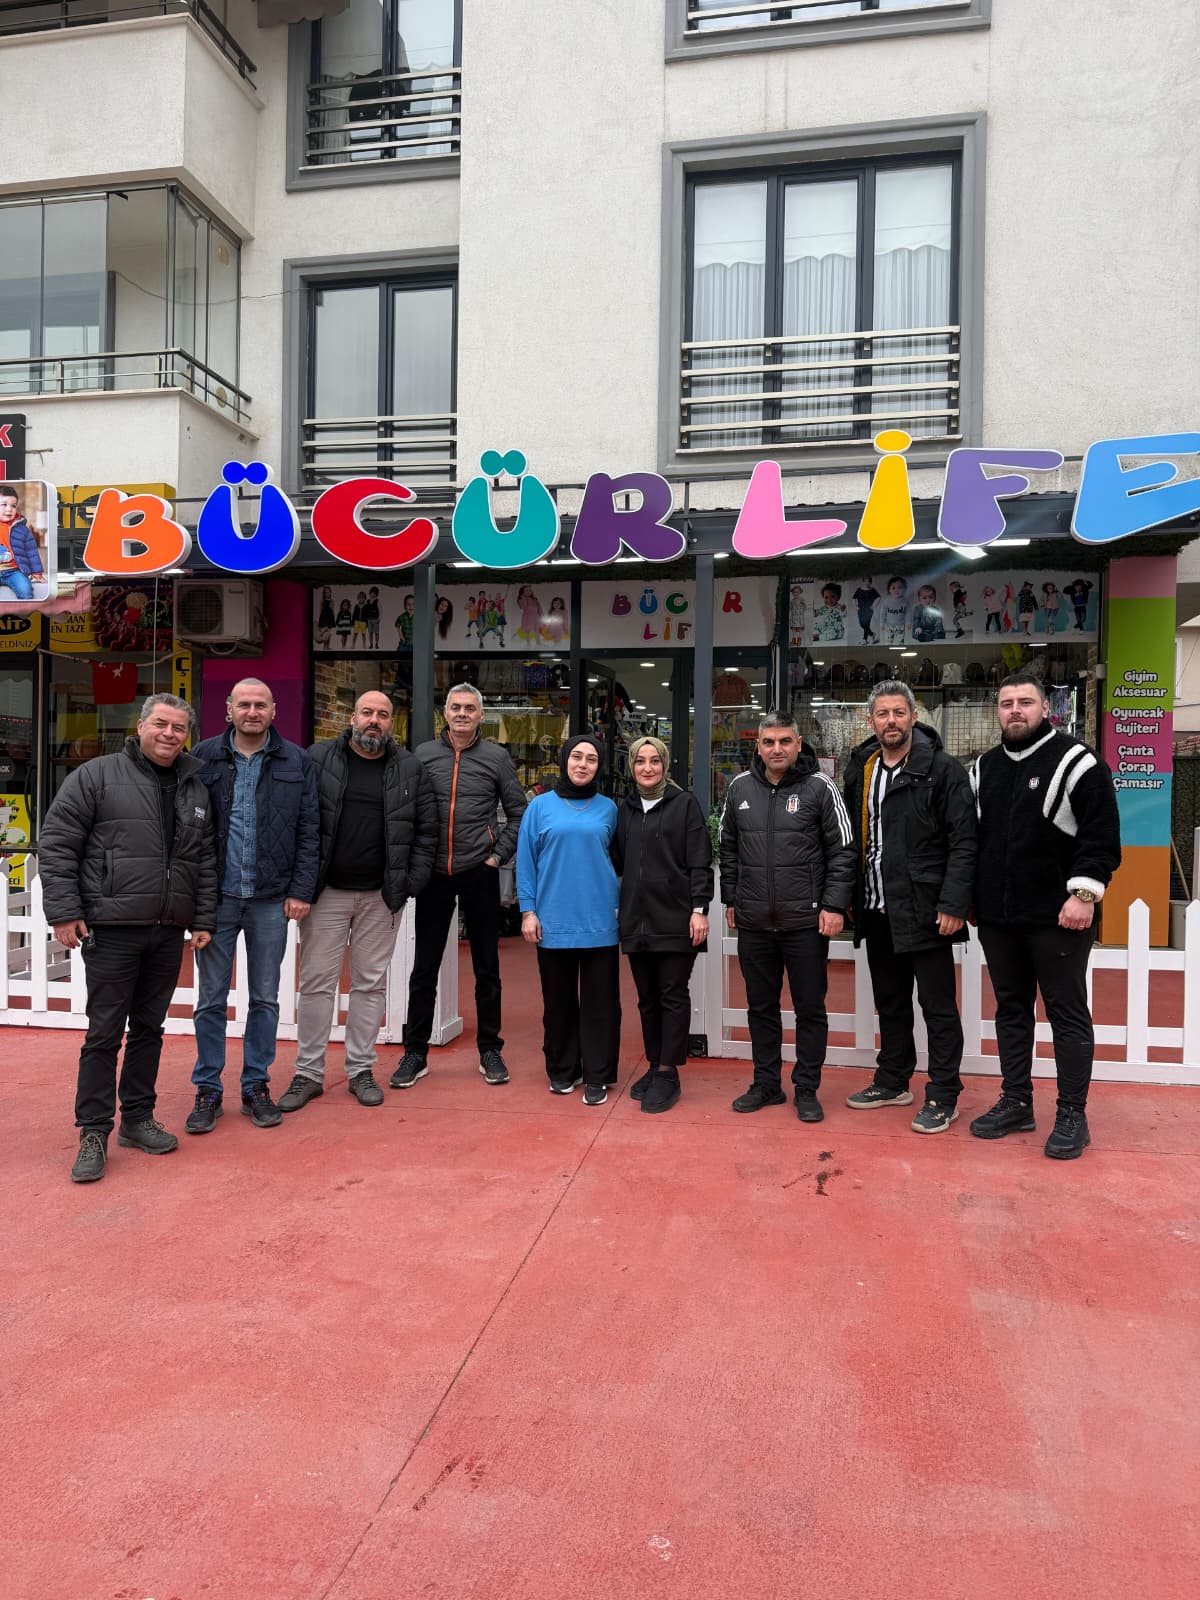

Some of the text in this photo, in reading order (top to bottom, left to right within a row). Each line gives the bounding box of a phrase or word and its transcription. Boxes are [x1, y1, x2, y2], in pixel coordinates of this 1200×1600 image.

[83, 429, 1200, 576] BÜCÜR LİFE
[611, 589, 743, 616] BÜCR
[65, 625, 86, 633] TAZE
[643, 617, 692, 641] LİF
[1124, 670, 1157, 684] Giyim
[1114, 687, 1167, 697] Aksesuar
[1111, 706, 1164, 720] Oyuncak
[1115, 722, 1159, 736] Bujiteri
[1117, 745, 1154, 758] Çanta
[1118, 761, 1155, 775] Çorap
